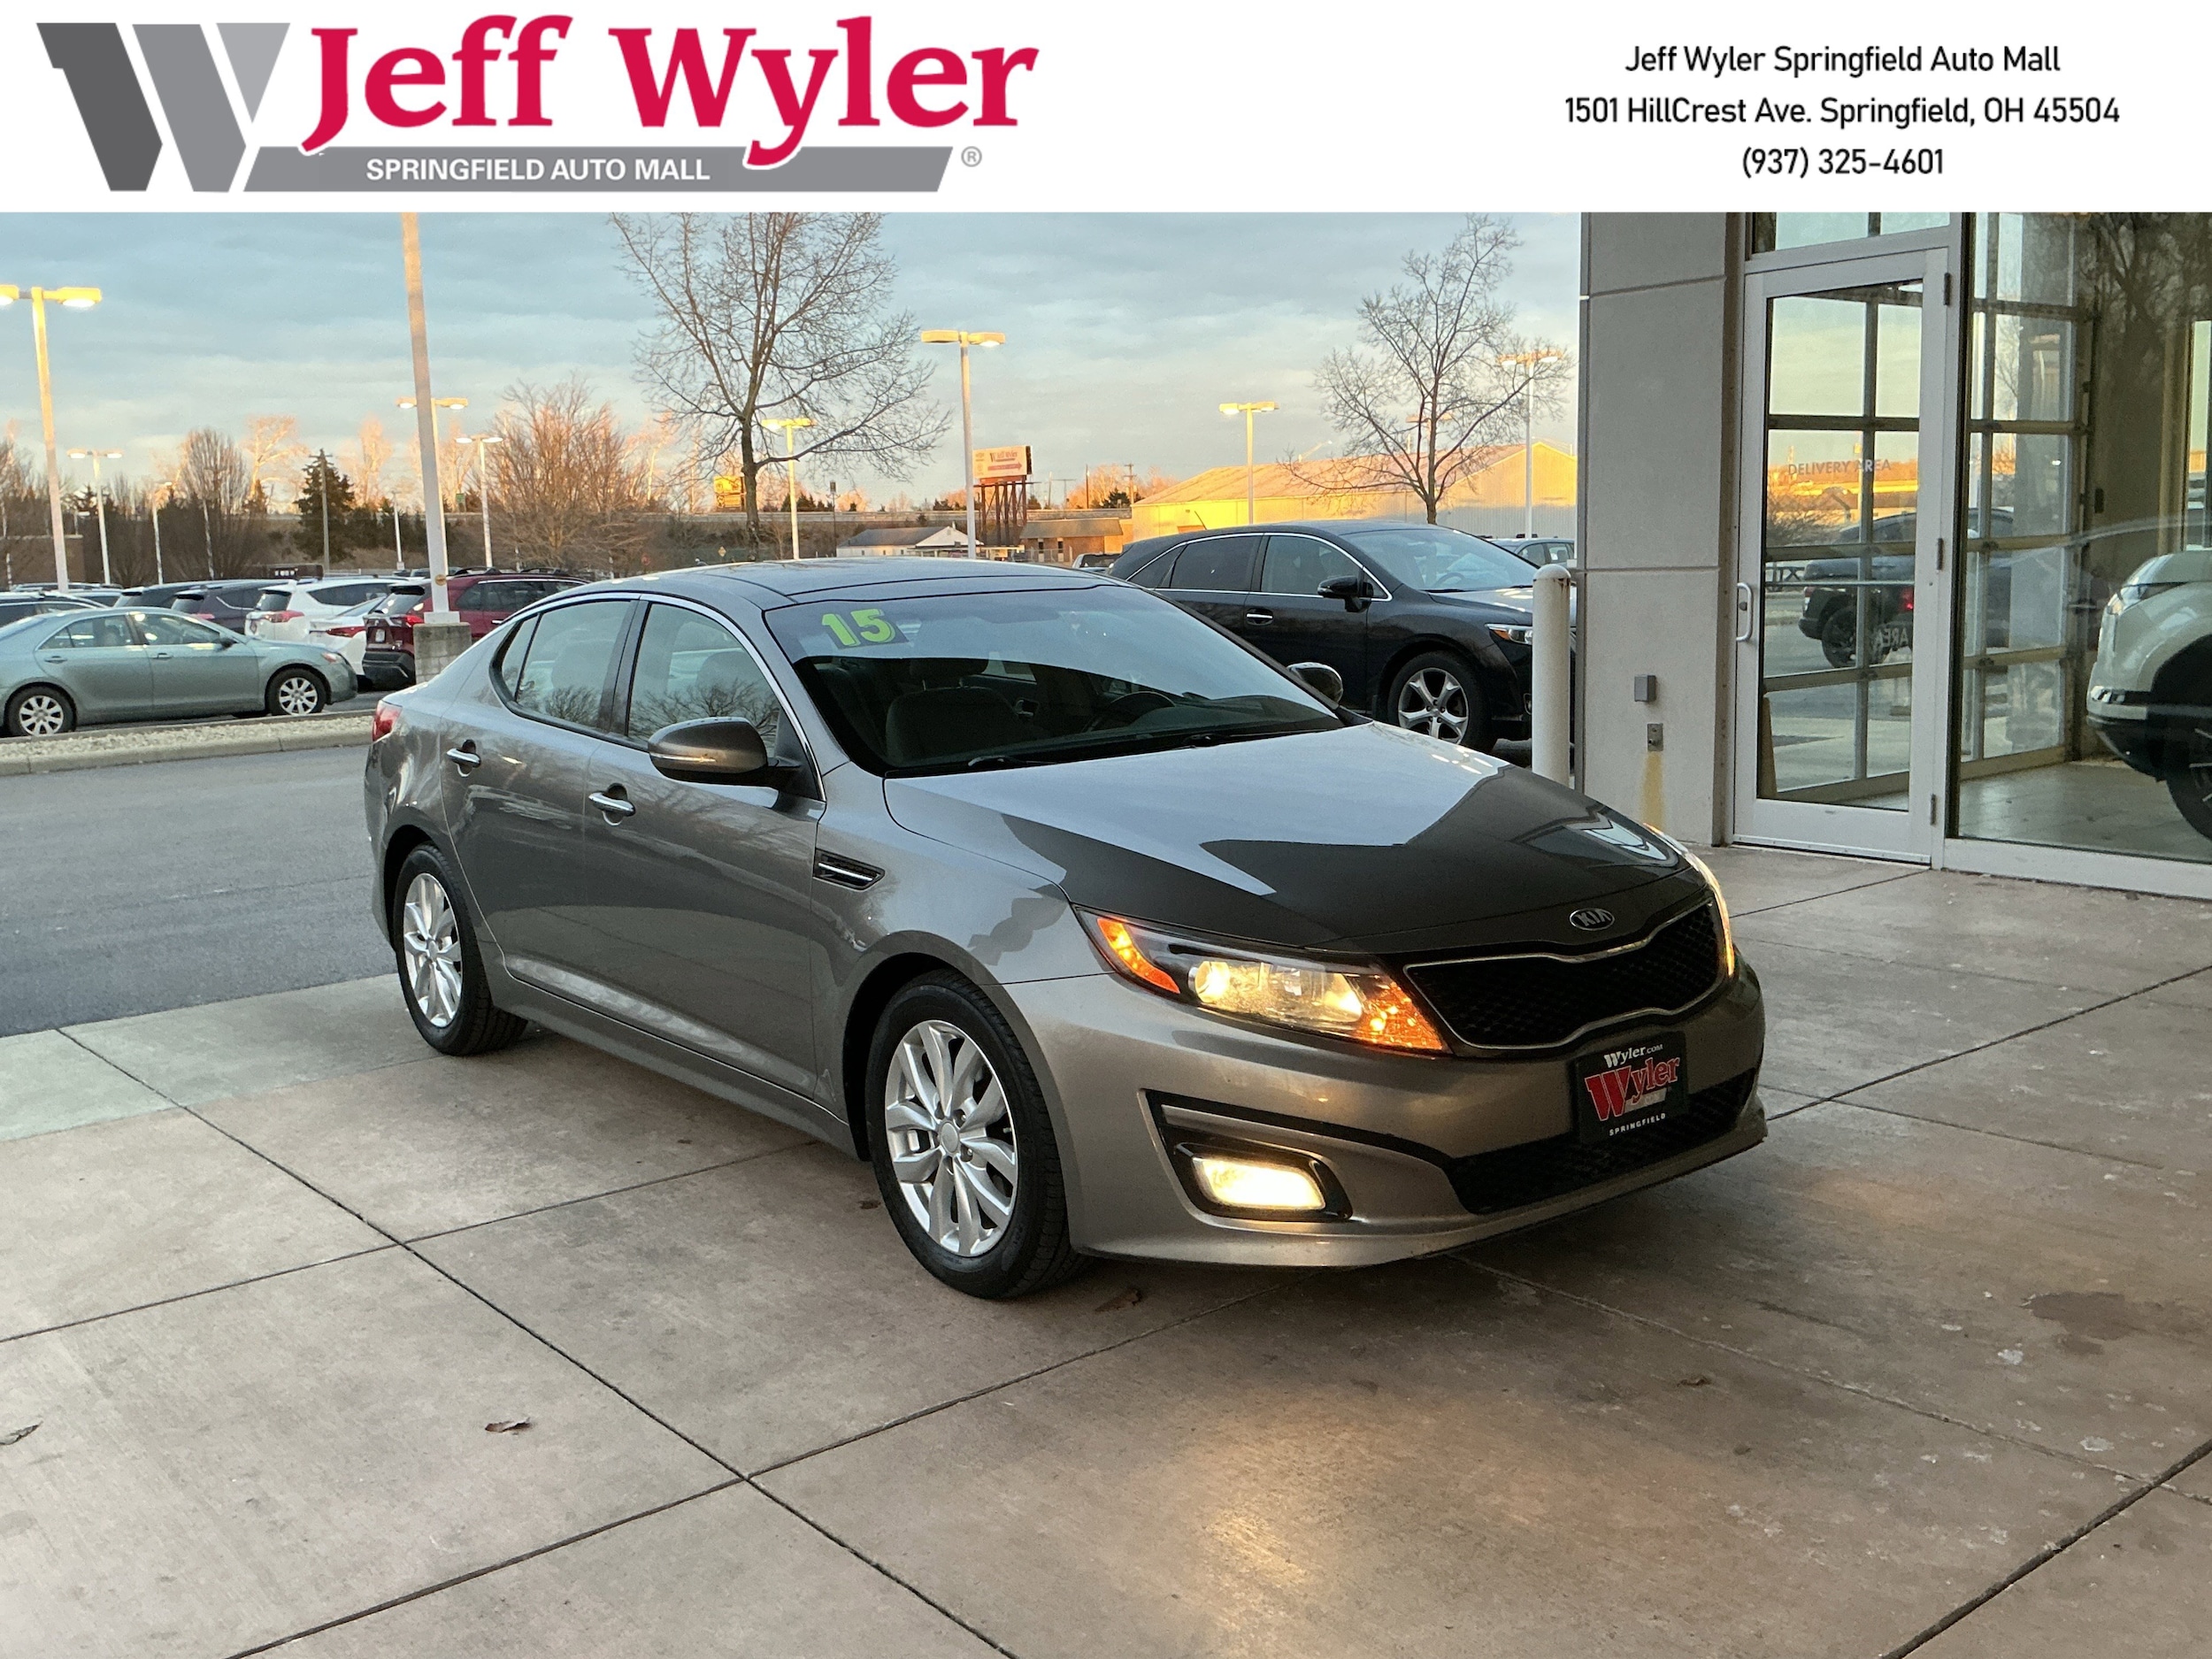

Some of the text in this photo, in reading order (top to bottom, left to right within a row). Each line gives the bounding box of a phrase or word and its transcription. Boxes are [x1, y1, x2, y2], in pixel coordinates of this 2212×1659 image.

[1788, 458, 1892, 476] DELIVERY AREA
[821, 608, 895, 647] 15
[1573, 910, 1612, 927] KIA
[1584, 1056, 1680, 1122] Wyler
[1609, 1112, 1666, 1137] SPRINGFIELD
